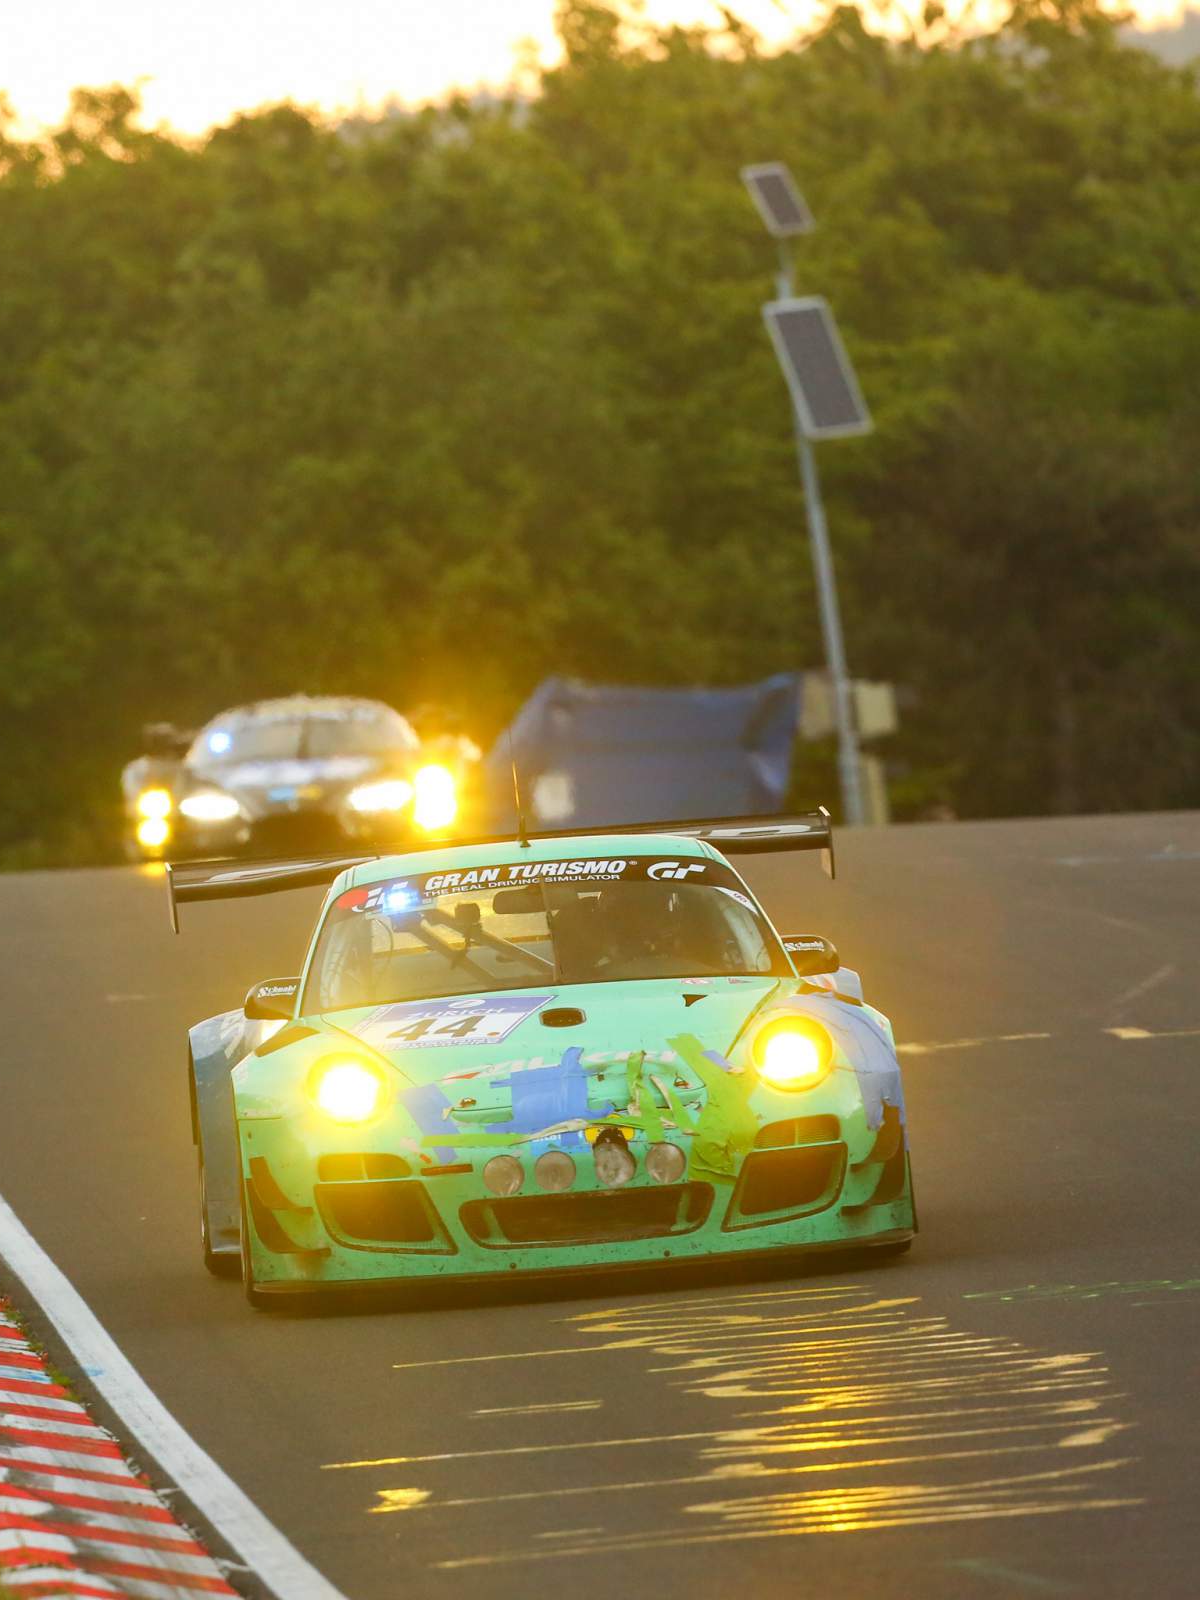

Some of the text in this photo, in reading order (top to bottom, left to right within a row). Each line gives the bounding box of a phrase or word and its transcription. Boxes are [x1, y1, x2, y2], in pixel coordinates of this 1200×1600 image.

[424, 860, 628, 891] GRAN TURISMO
[424, 874, 621, 898] THE REAL DRIVING SIMULATOR
[385, 1015, 487, 1042] 44
